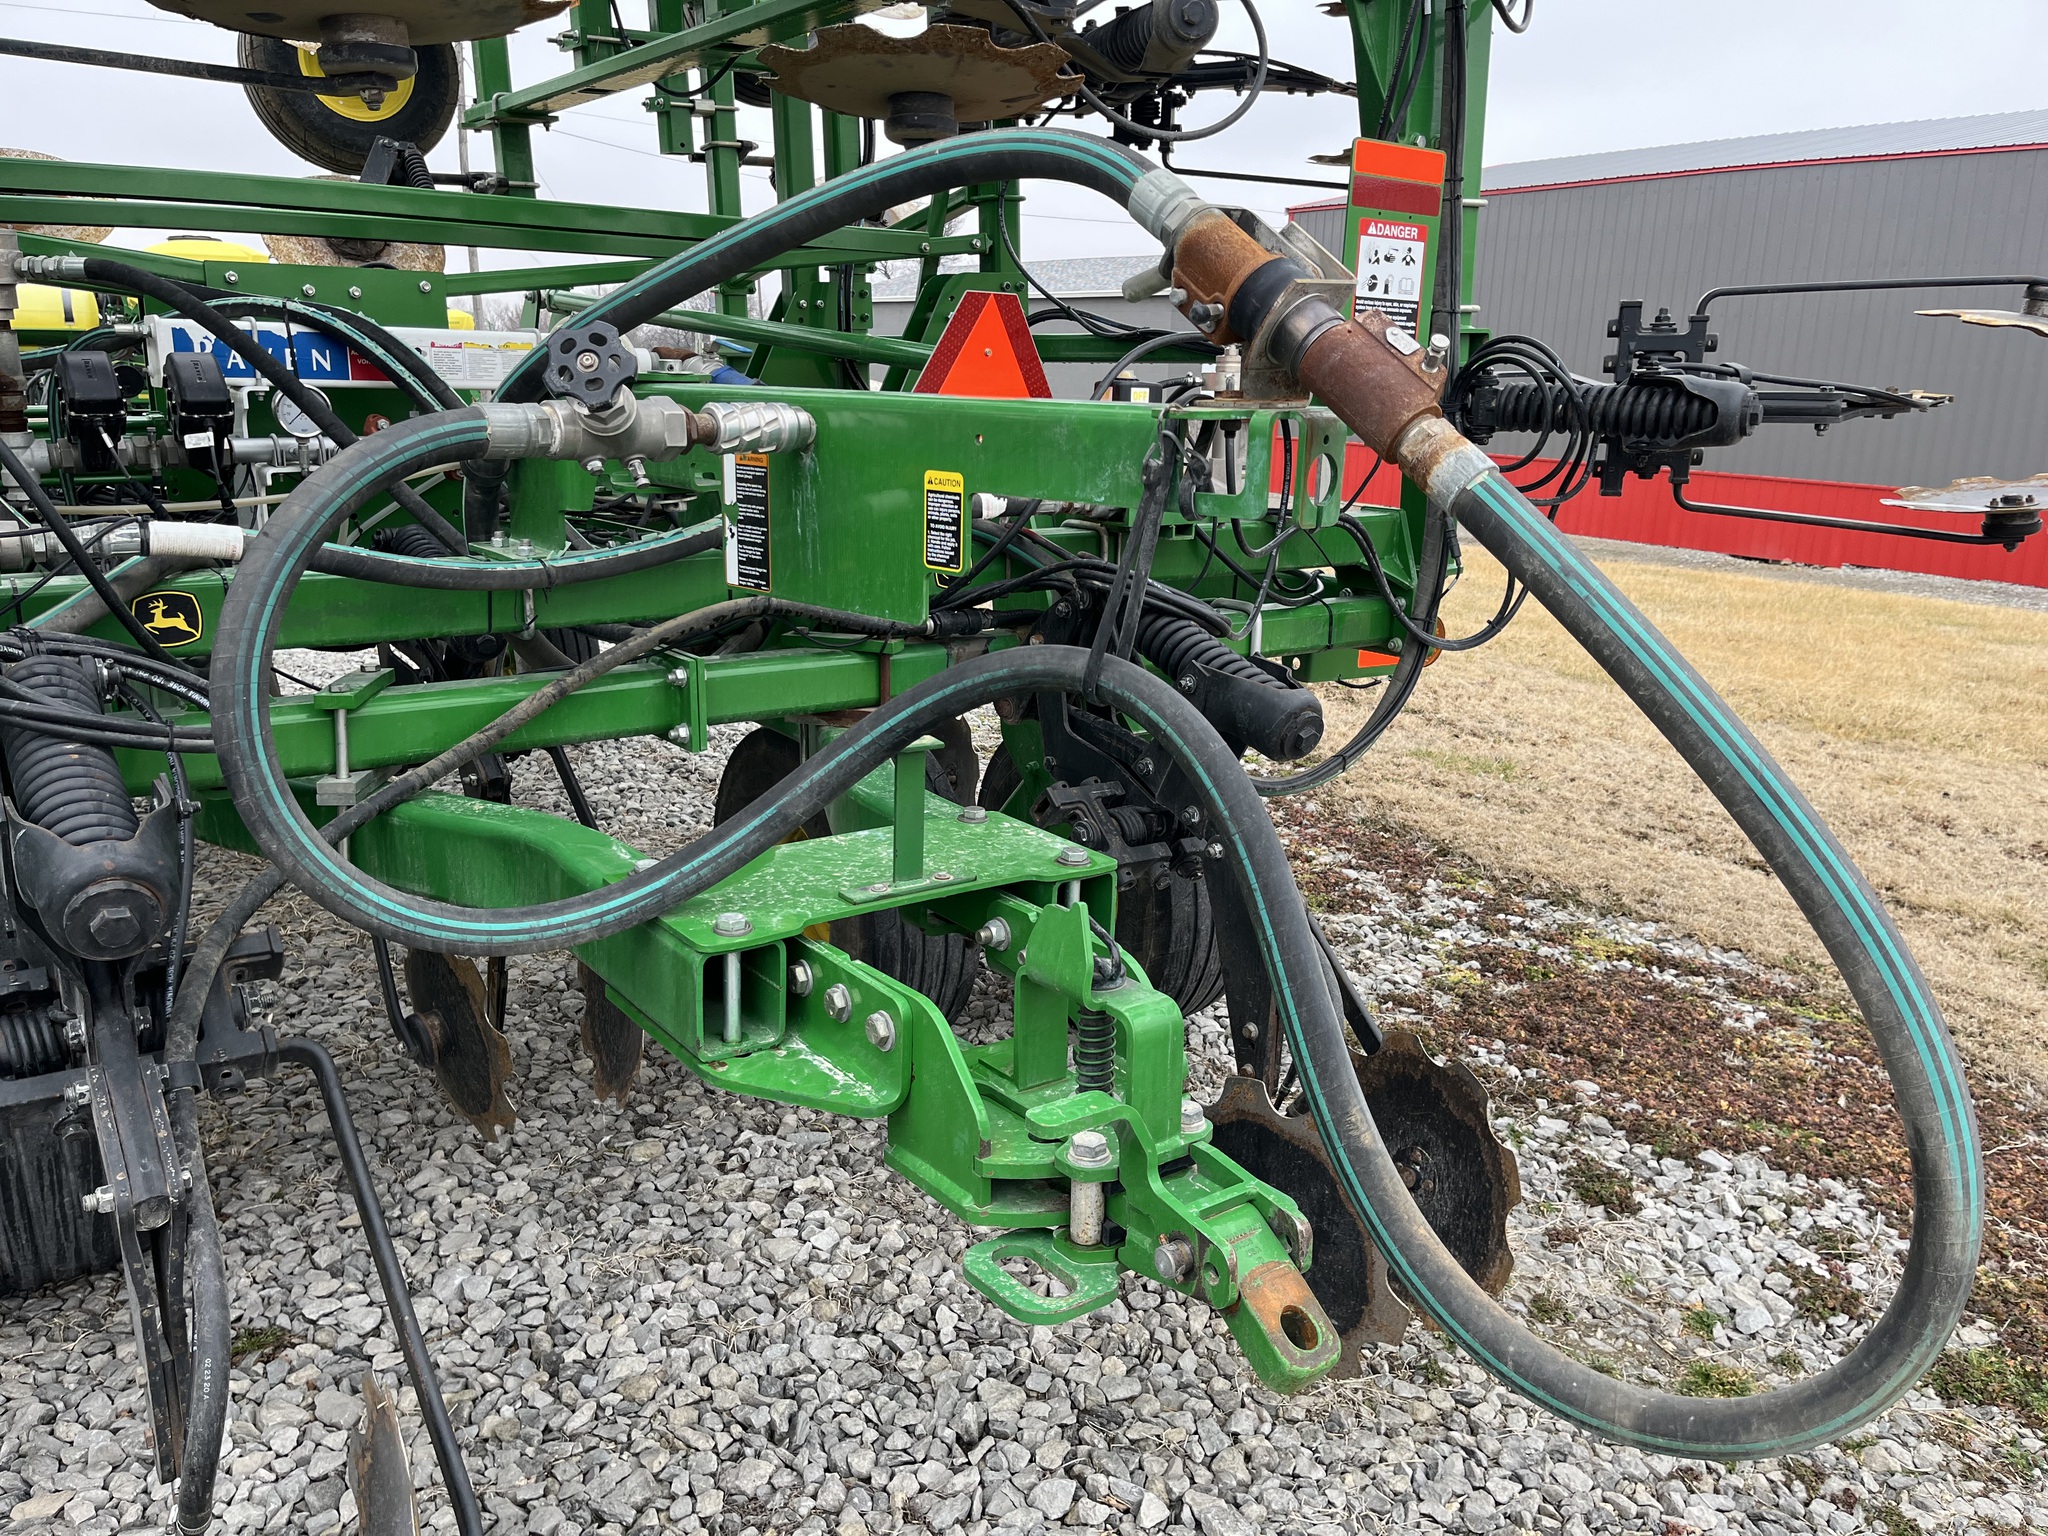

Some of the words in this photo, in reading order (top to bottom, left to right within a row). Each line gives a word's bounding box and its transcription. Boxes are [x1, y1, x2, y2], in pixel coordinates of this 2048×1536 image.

[1377, 223, 1418, 240] DANGER
[934, 477, 961, 488] CAUTION
[204, 1358, 212, 1368] 02
[204, 1370, 211, 1380] 23
